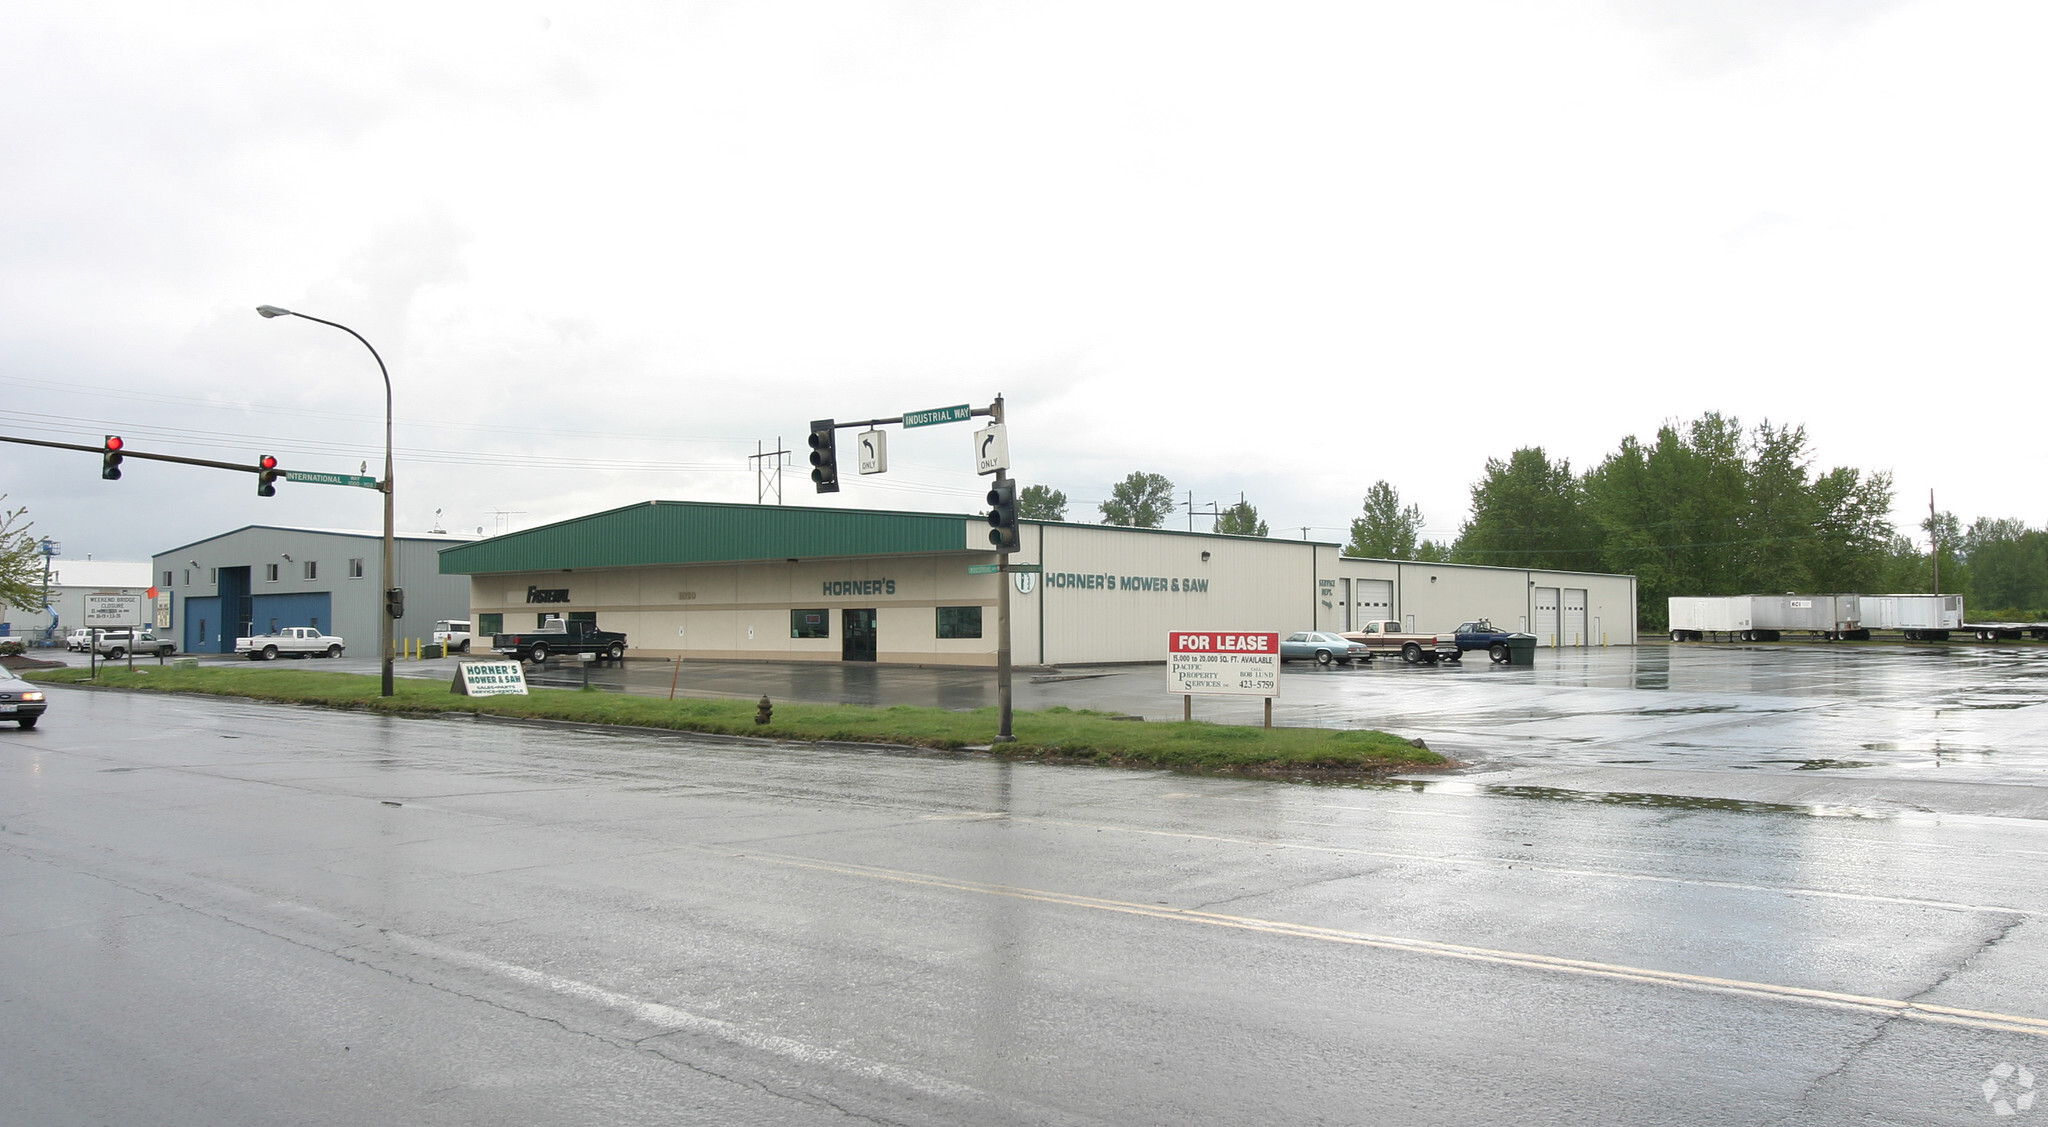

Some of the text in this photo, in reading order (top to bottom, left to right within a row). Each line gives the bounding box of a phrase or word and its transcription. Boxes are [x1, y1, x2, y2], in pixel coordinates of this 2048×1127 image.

[906, 407, 970, 426] INDUSTRIAL WAY
[862, 460, 876, 470] ONLY
[980, 458, 998, 470] ONLY
[287, 472, 342, 484] INTERNATIONAL
[823, 578, 896, 596] HORNER'S
[1046, 572, 1209, 592] HORNER'S MOWER & SAW
[1319, 580, 1336, 588] SERVICE
[1178, 635, 1268, 651] FOR LEASE
[1240, 656, 1273, 664] AVAILABLE
[466, 665, 518, 675] HORNER'S
[1172, 664, 1202, 674] PACIFIC
[504, 676, 521, 684] SAW
[1179, 672, 1218, 682] PROPERTY
[1184, 681, 1221, 690] SERVICES
[1238, 680, 1274, 689] 423-5759
